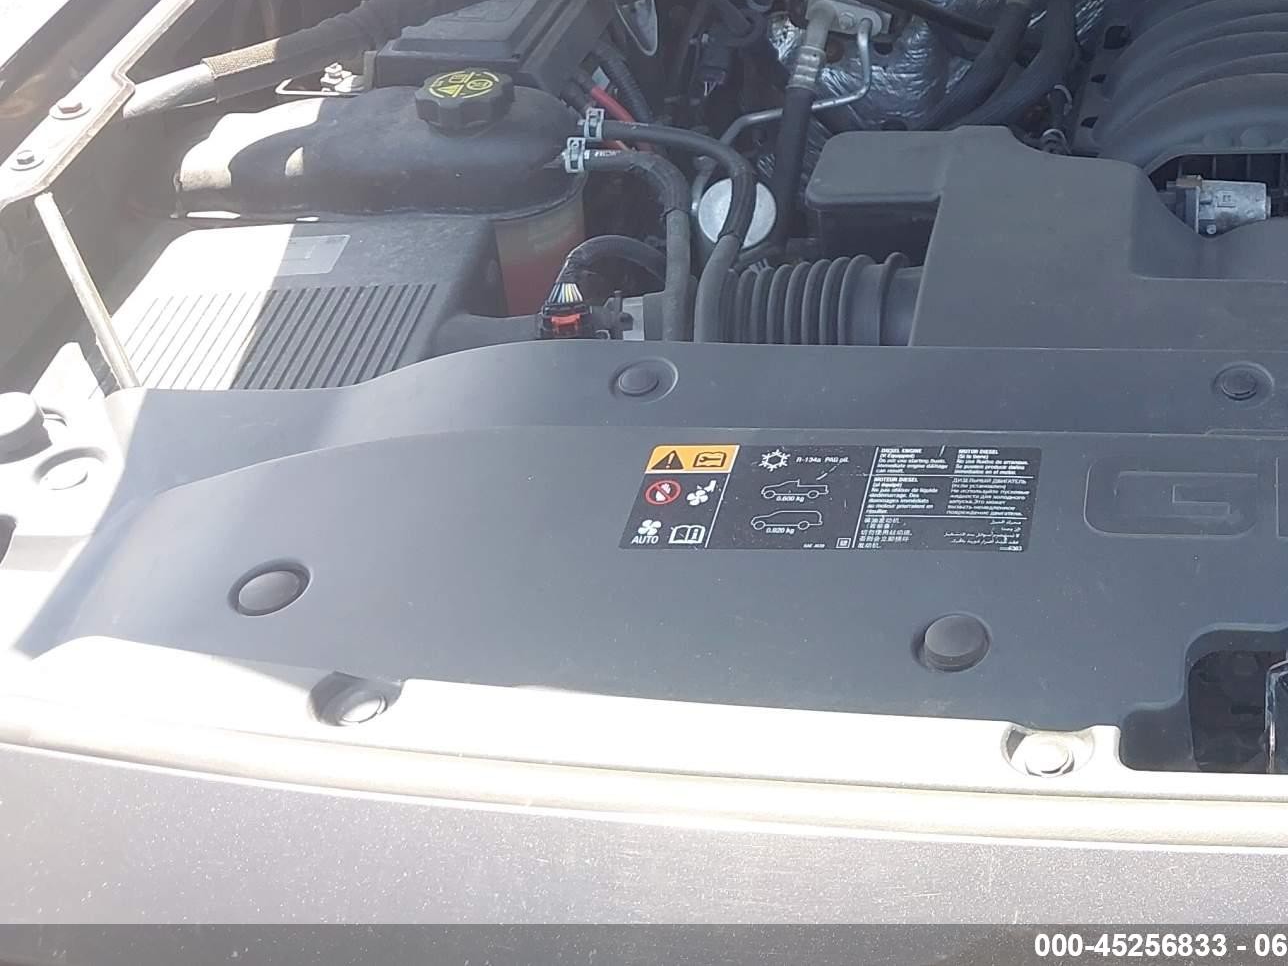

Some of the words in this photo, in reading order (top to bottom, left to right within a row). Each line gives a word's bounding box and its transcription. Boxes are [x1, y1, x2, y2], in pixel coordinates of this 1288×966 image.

[795, 495, 805, 503] kg
[785, 527, 795, 535] kg
[631, 535, 660, 544] AUTO
